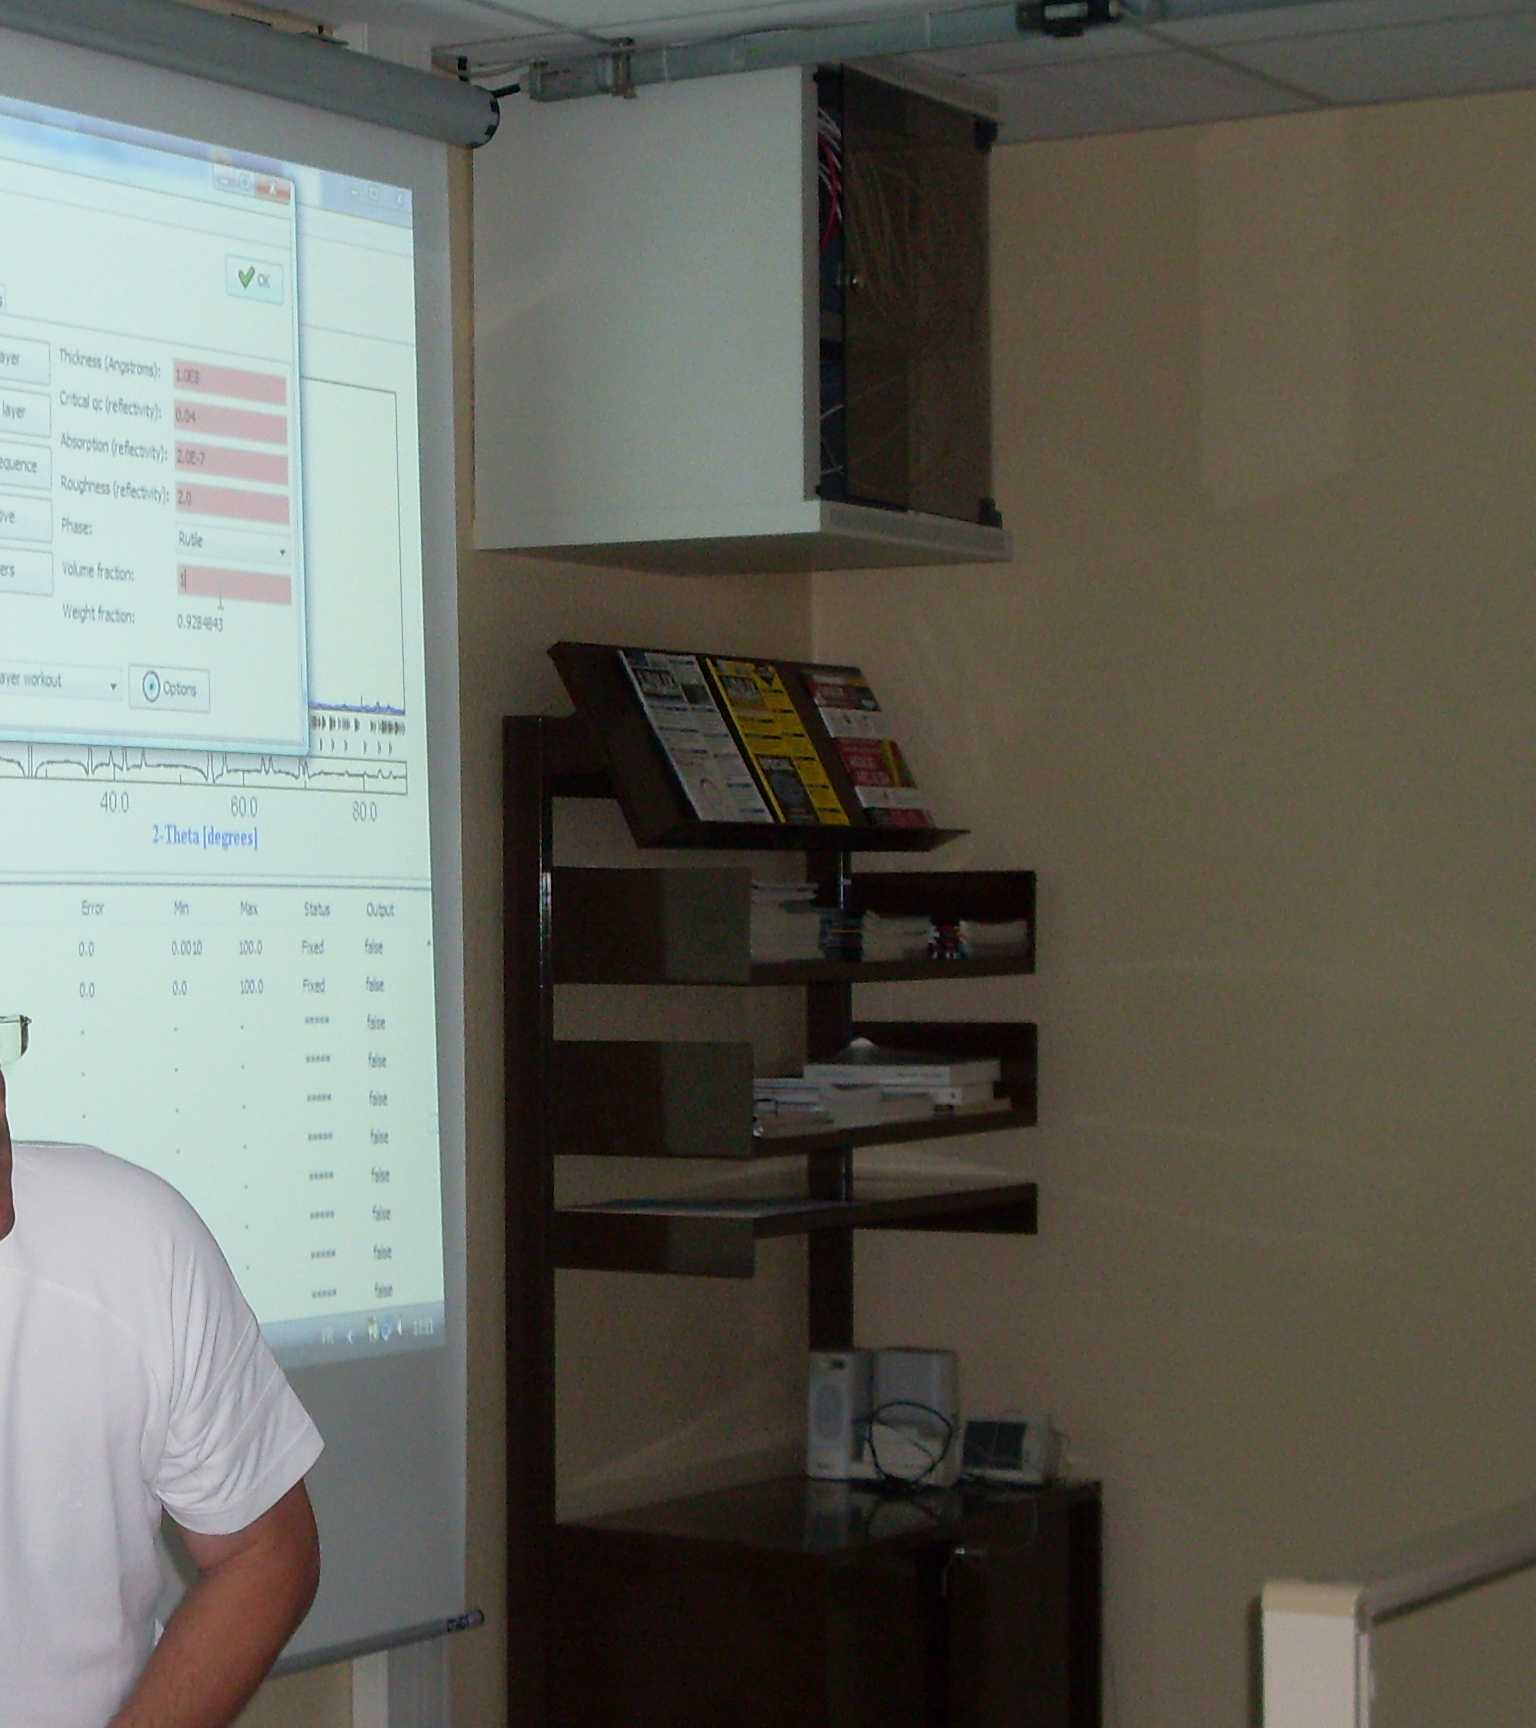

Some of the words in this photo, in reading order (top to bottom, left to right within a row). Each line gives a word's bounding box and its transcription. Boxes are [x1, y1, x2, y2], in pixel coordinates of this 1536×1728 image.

[59, 348, 102, 369] Thickness
[60, 389, 90, 409] Critical
[2, 399, 26, 420] layer
[60, 432, 110, 453] Absorption
[60, 475, 110, 495] Roughness
[178, 531, 203, 549] Rutile
[62, 560, 94, 577] Volume
[63, 603, 95, 623] Weight
[23, 671, 62, 688] workout
[163, 680, 197, 698] Options
[99, 791, 130, 814] 40.0
[230, 795, 258, 819] 60.0
[352, 801, 377, 822] 80.0
[151, 824, 200, 847] 2-Theta
[81, 900, 104, 917] Error
[174, 900, 190, 917] Min
[240, 901, 259, 917] Max
[304, 901, 331, 918] Status
[366, 902, 395, 918] Output
[78, 939, 95, 958] 0.0
[171, 939, 203, 957] 0.0010
[239, 939, 263, 956] 100.0
[301, 938, 325, 955] Fixed
[364, 938, 384, 955] false
[79, 980, 95, 998] 0.0
[172, 979, 188, 997] 0.0
[240, 978, 263, 995] 100.0
[302, 977, 325, 994] Fixed
[365, 976, 385, 993] false
[366, 1013, 386, 1031] false
[368, 1051, 387, 1069] false
